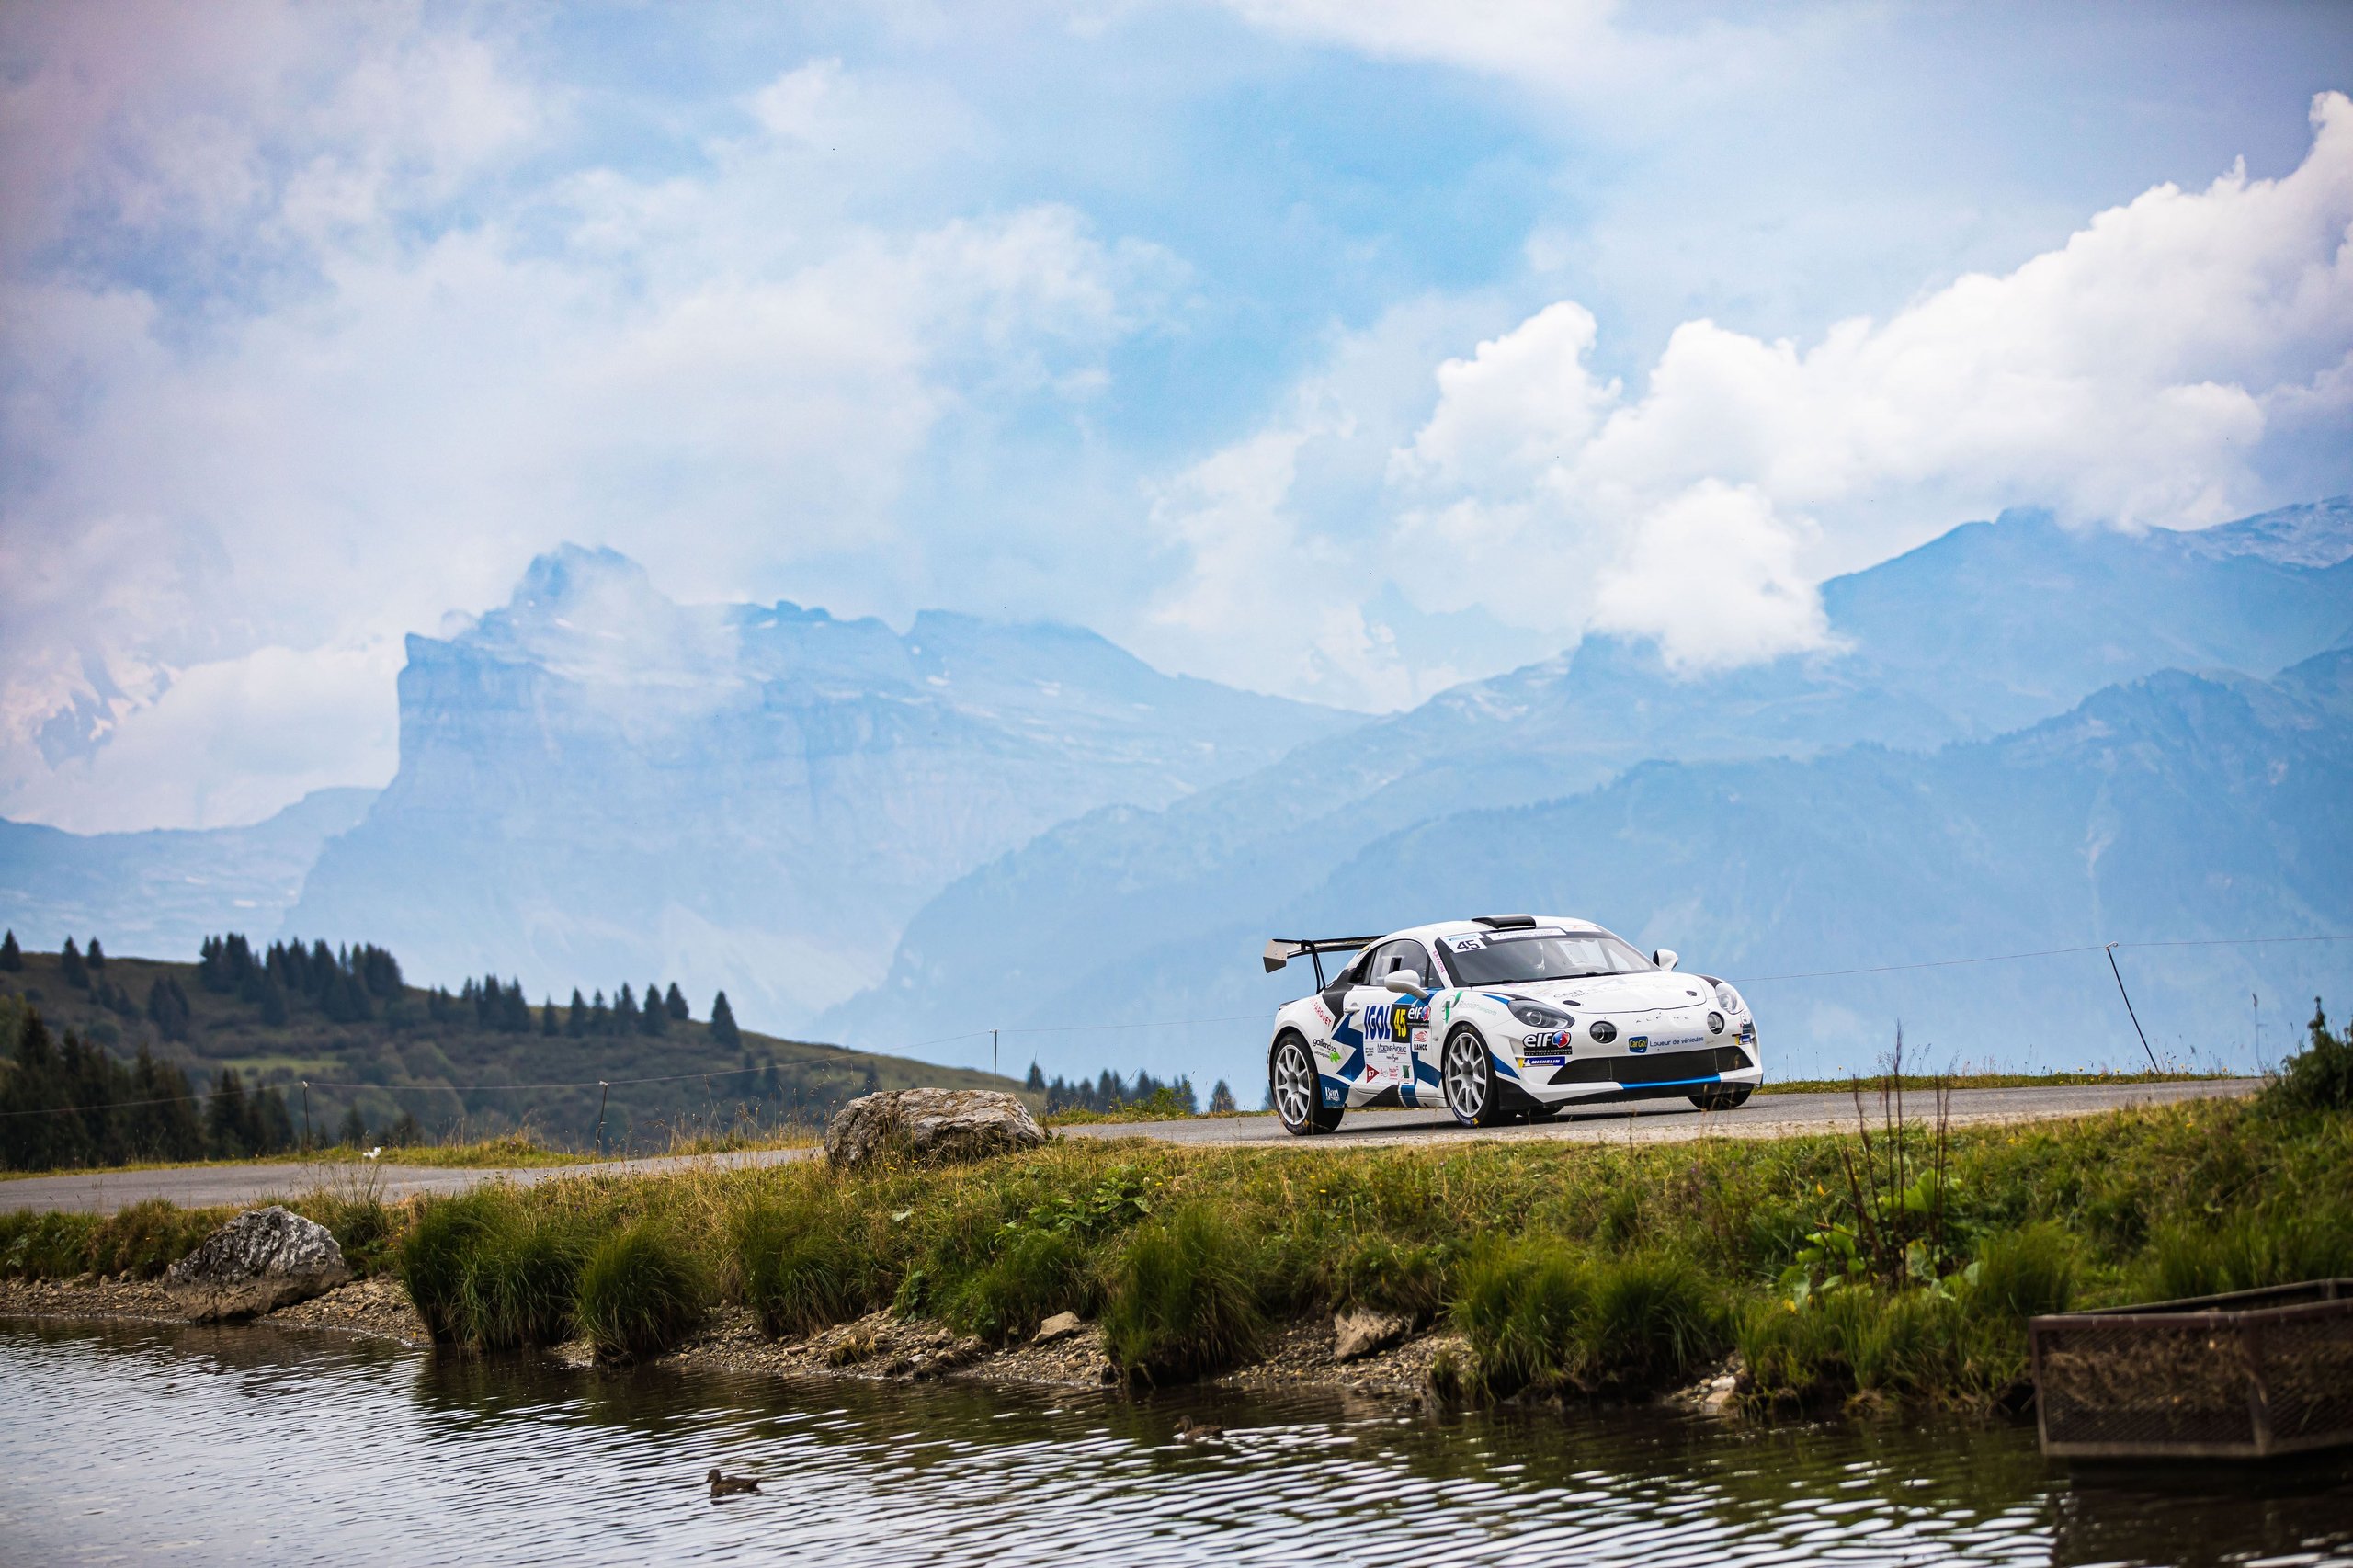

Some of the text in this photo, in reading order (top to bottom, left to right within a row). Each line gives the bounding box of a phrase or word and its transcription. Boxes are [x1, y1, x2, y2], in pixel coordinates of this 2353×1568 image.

[1457, 939, 1481, 950] 45
[1407, 1006, 1423, 1020] elf
[1635, 1014, 1689, 1023] ALPNE
[1364, 1005, 1390, 1040] IGOL
[1393, 1008, 1407, 1038] 45
[1523, 1033, 1552, 1048] elf
[1629, 1039, 1648, 1048] CarGo!
[1681, 1036, 1704, 1044] véhicules
